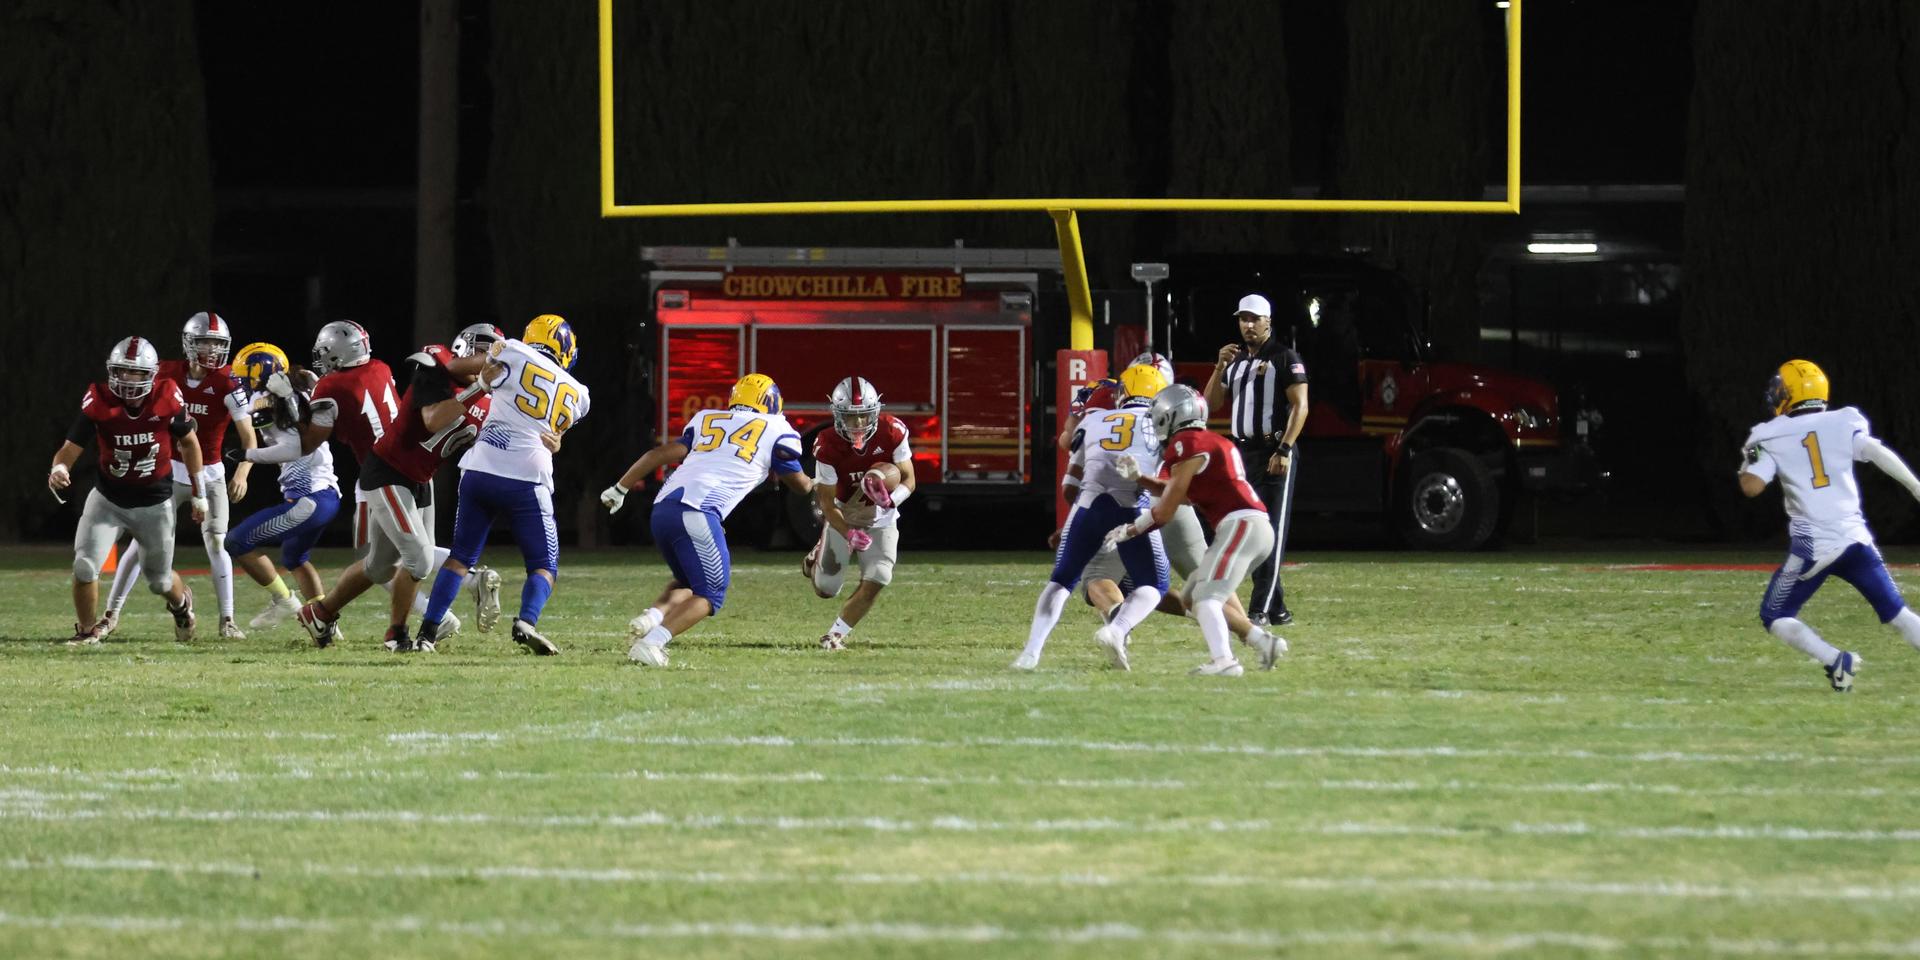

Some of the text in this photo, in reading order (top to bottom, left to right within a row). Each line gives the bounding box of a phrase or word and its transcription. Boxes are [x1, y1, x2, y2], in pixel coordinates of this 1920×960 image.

[724, 276, 962, 297] CHOWCHILLA FIRE
[361, 382, 399, 444] 11
[514, 361, 579, 434] 56
[114, 432, 155, 446] TRIBE
[693, 413, 768, 464] 54
[1099, 413, 1136, 451] 3
[1801, 431, 1831, 489] 1
